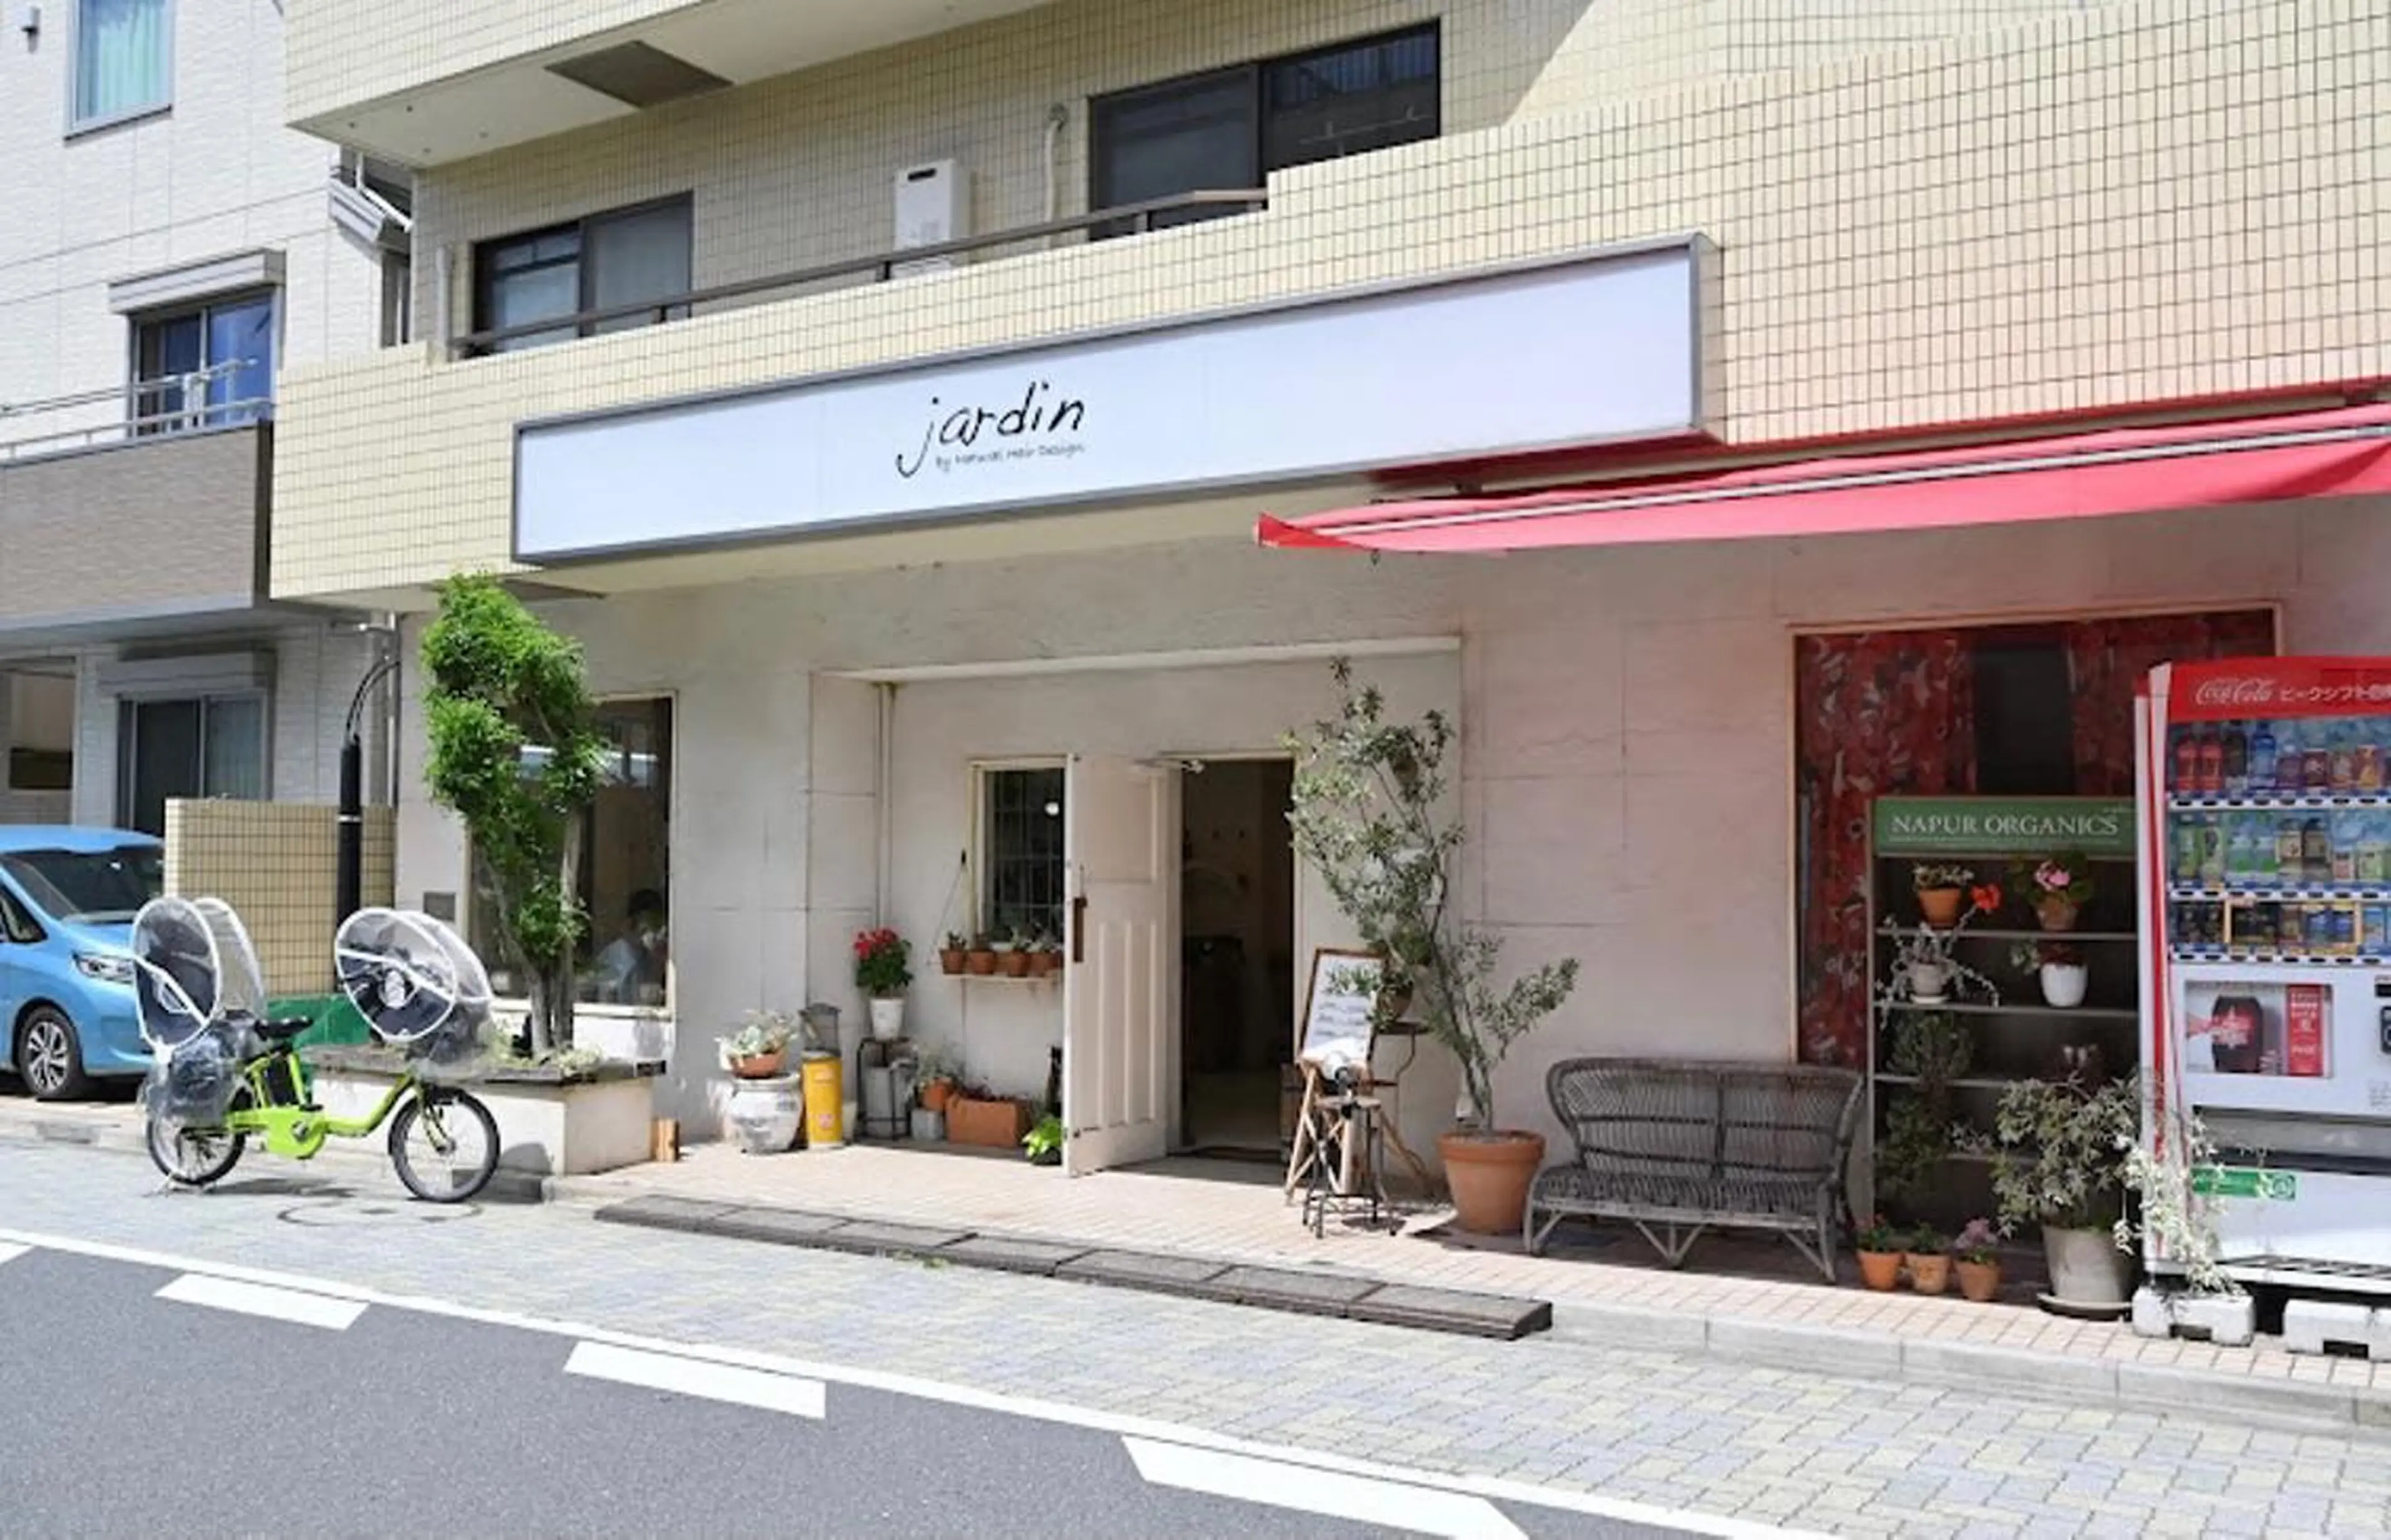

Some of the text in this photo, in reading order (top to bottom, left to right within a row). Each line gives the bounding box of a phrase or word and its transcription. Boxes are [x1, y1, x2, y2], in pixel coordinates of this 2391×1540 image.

[895, 381, 1085, 478] jardin
[1890, 814, 2118, 836] NAPUR ORGANICS
